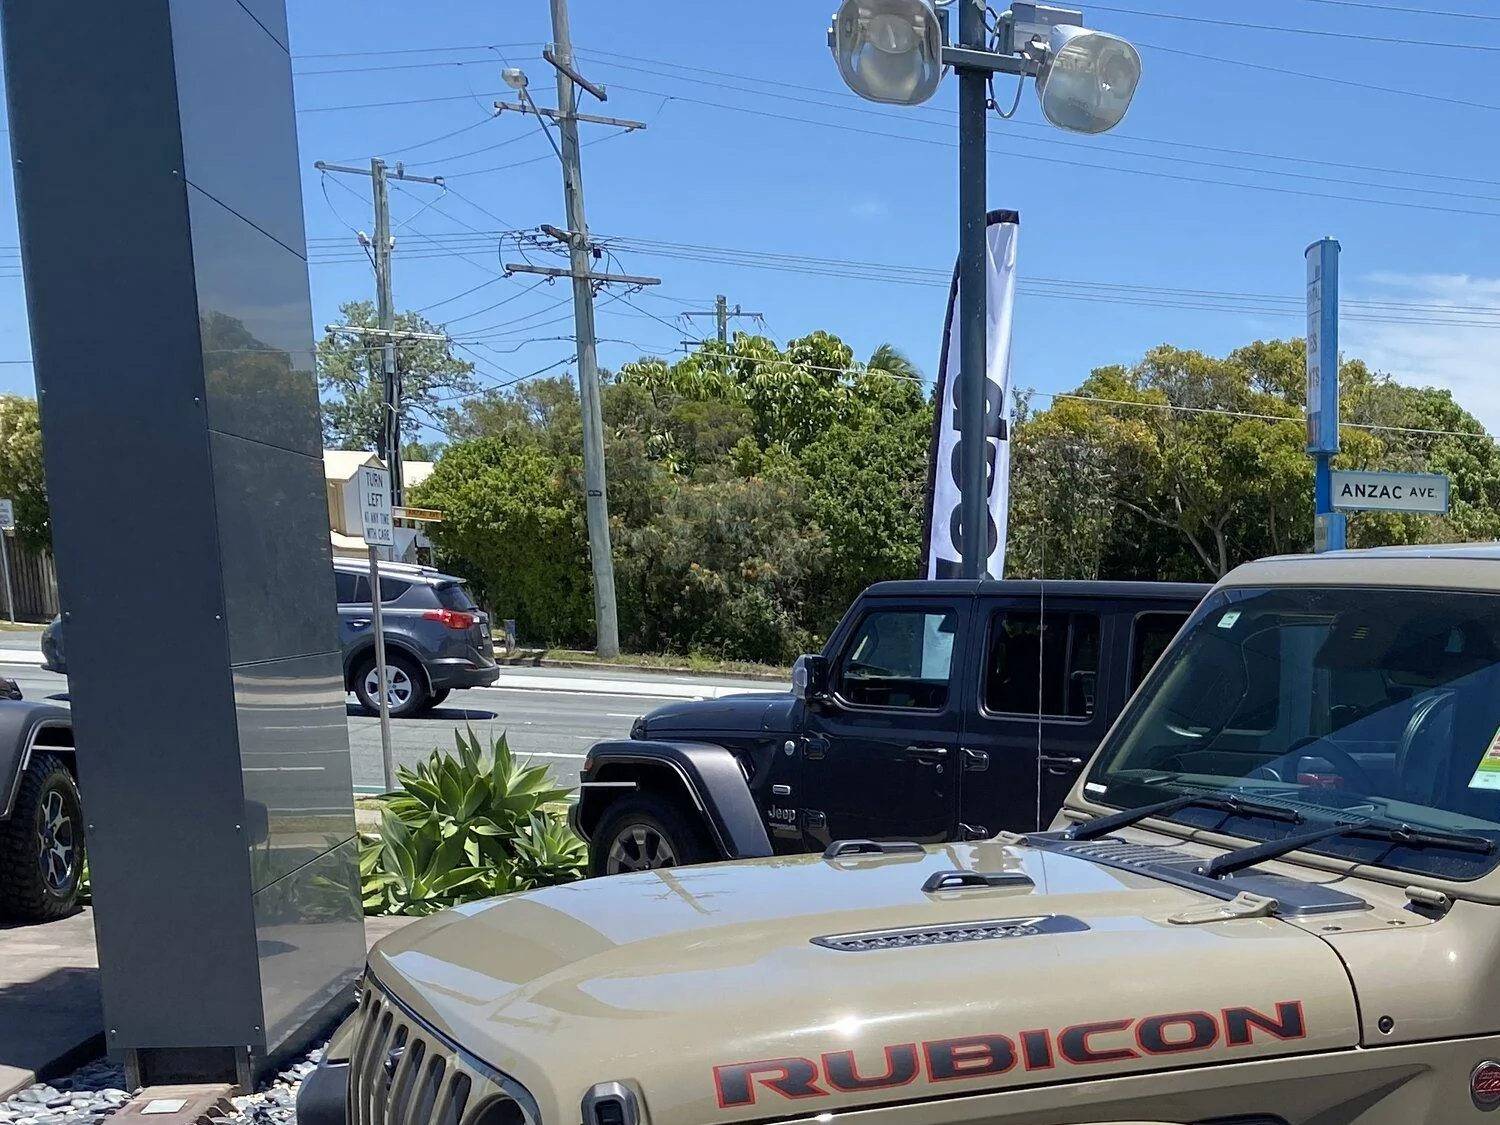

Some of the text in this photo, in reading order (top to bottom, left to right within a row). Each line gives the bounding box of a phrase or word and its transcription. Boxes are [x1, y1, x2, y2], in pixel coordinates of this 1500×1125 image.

[366, 472, 383, 488] TURN
[368, 492, 382, 507] LEFT
[1341, 483, 1402, 500] ANZAC
[371, 512, 379, 524] ANY
[380, 513, 389, 525] TIME
[367, 527, 390, 541] WITH CARE
[768, 804, 796, 823] Jeep
[713, 999, 1306, 1109] RUBICON
